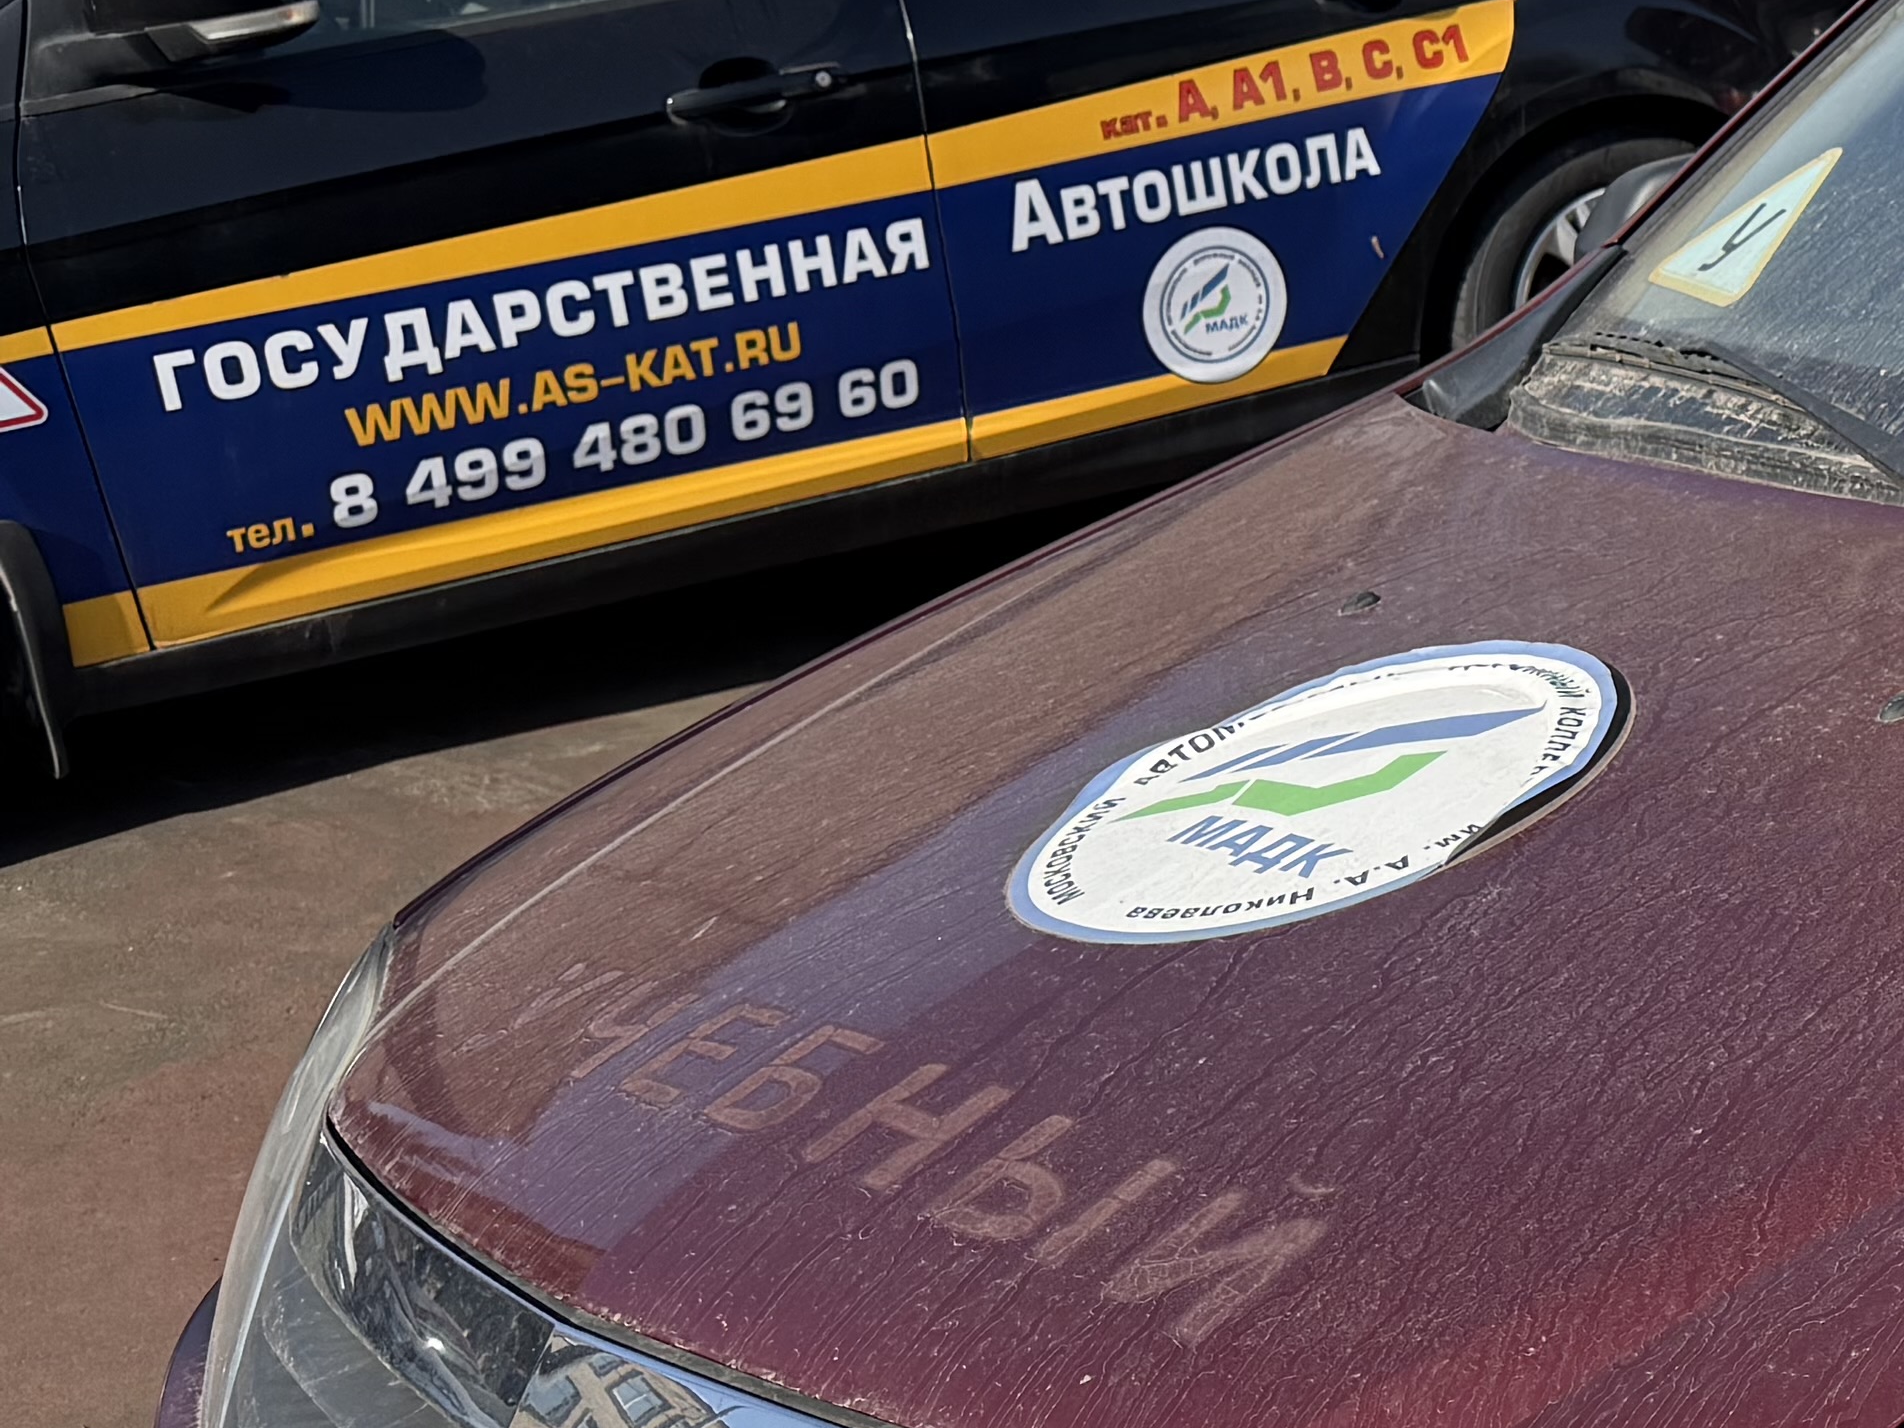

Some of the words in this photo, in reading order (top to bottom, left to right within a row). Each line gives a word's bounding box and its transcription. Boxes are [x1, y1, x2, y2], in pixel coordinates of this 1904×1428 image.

[1100, 109, 1168, 141] кат.
[153, 217, 930, 412] ГОСУДАРСТВЕННАЯ
[1205, 313, 1249, 334] МАДК
[344, 321, 801, 447] WWW.AS-KAT.RU
[226, 517, 315, 553] тел.
[329, 472, 379, 529] 8
[405, 437, 547, 509] 499
[573, 403, 706, 472] 480
[730, 381, 815, 441] 69
[838, 358, 920, 418] 60
[1043, 797, 1127, 905] МОСКОВСКИЙ
[1166, 814, 1354, 879] МАДК
[1126, 887, 1315, 920] Николаева
